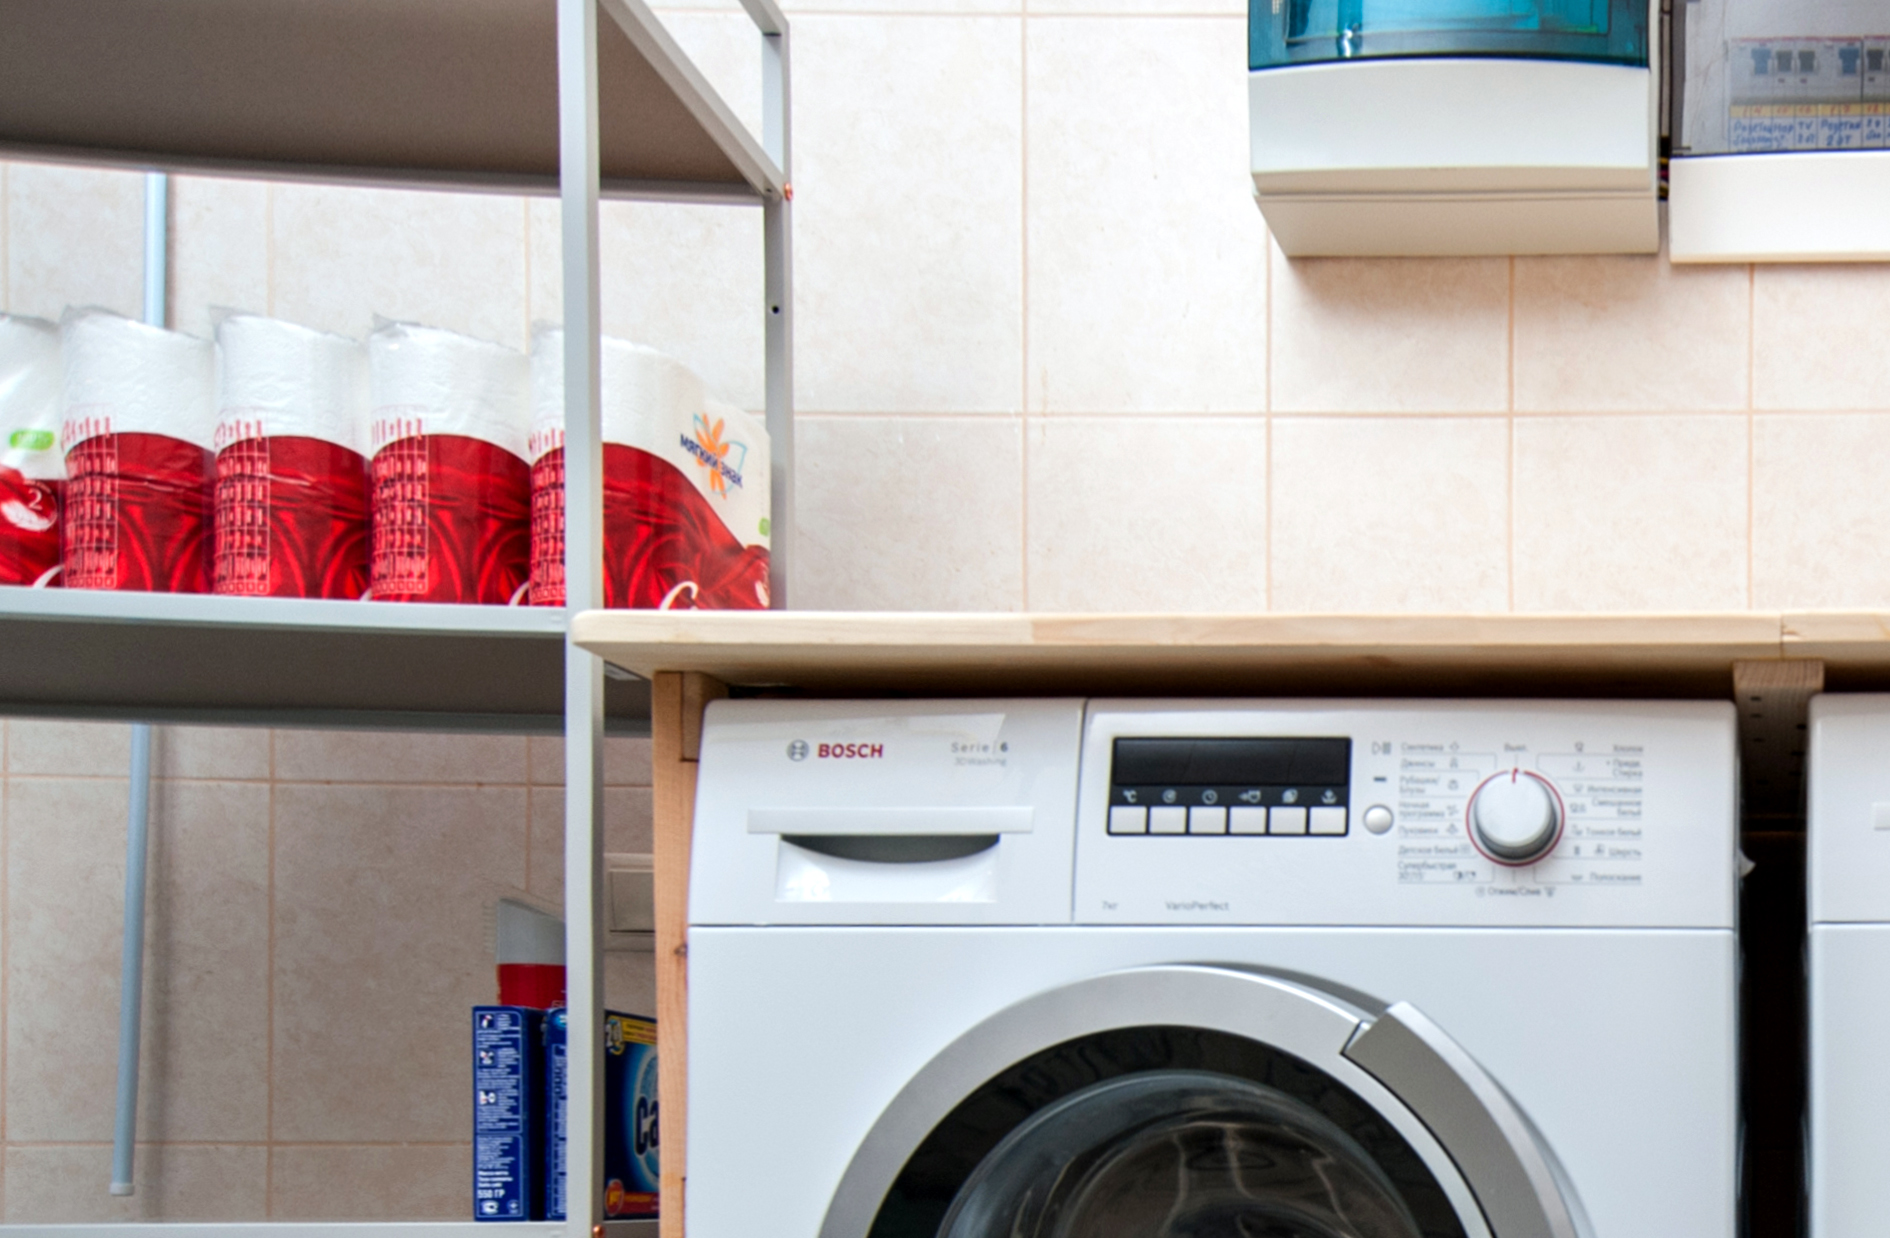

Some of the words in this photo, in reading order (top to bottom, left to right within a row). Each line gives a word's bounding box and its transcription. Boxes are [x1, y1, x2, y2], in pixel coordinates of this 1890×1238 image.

[818, 743, 884, 759] BOSCH
[951, 741, 989, 753] Serie
[1000, 741, 1009, 753] 6
